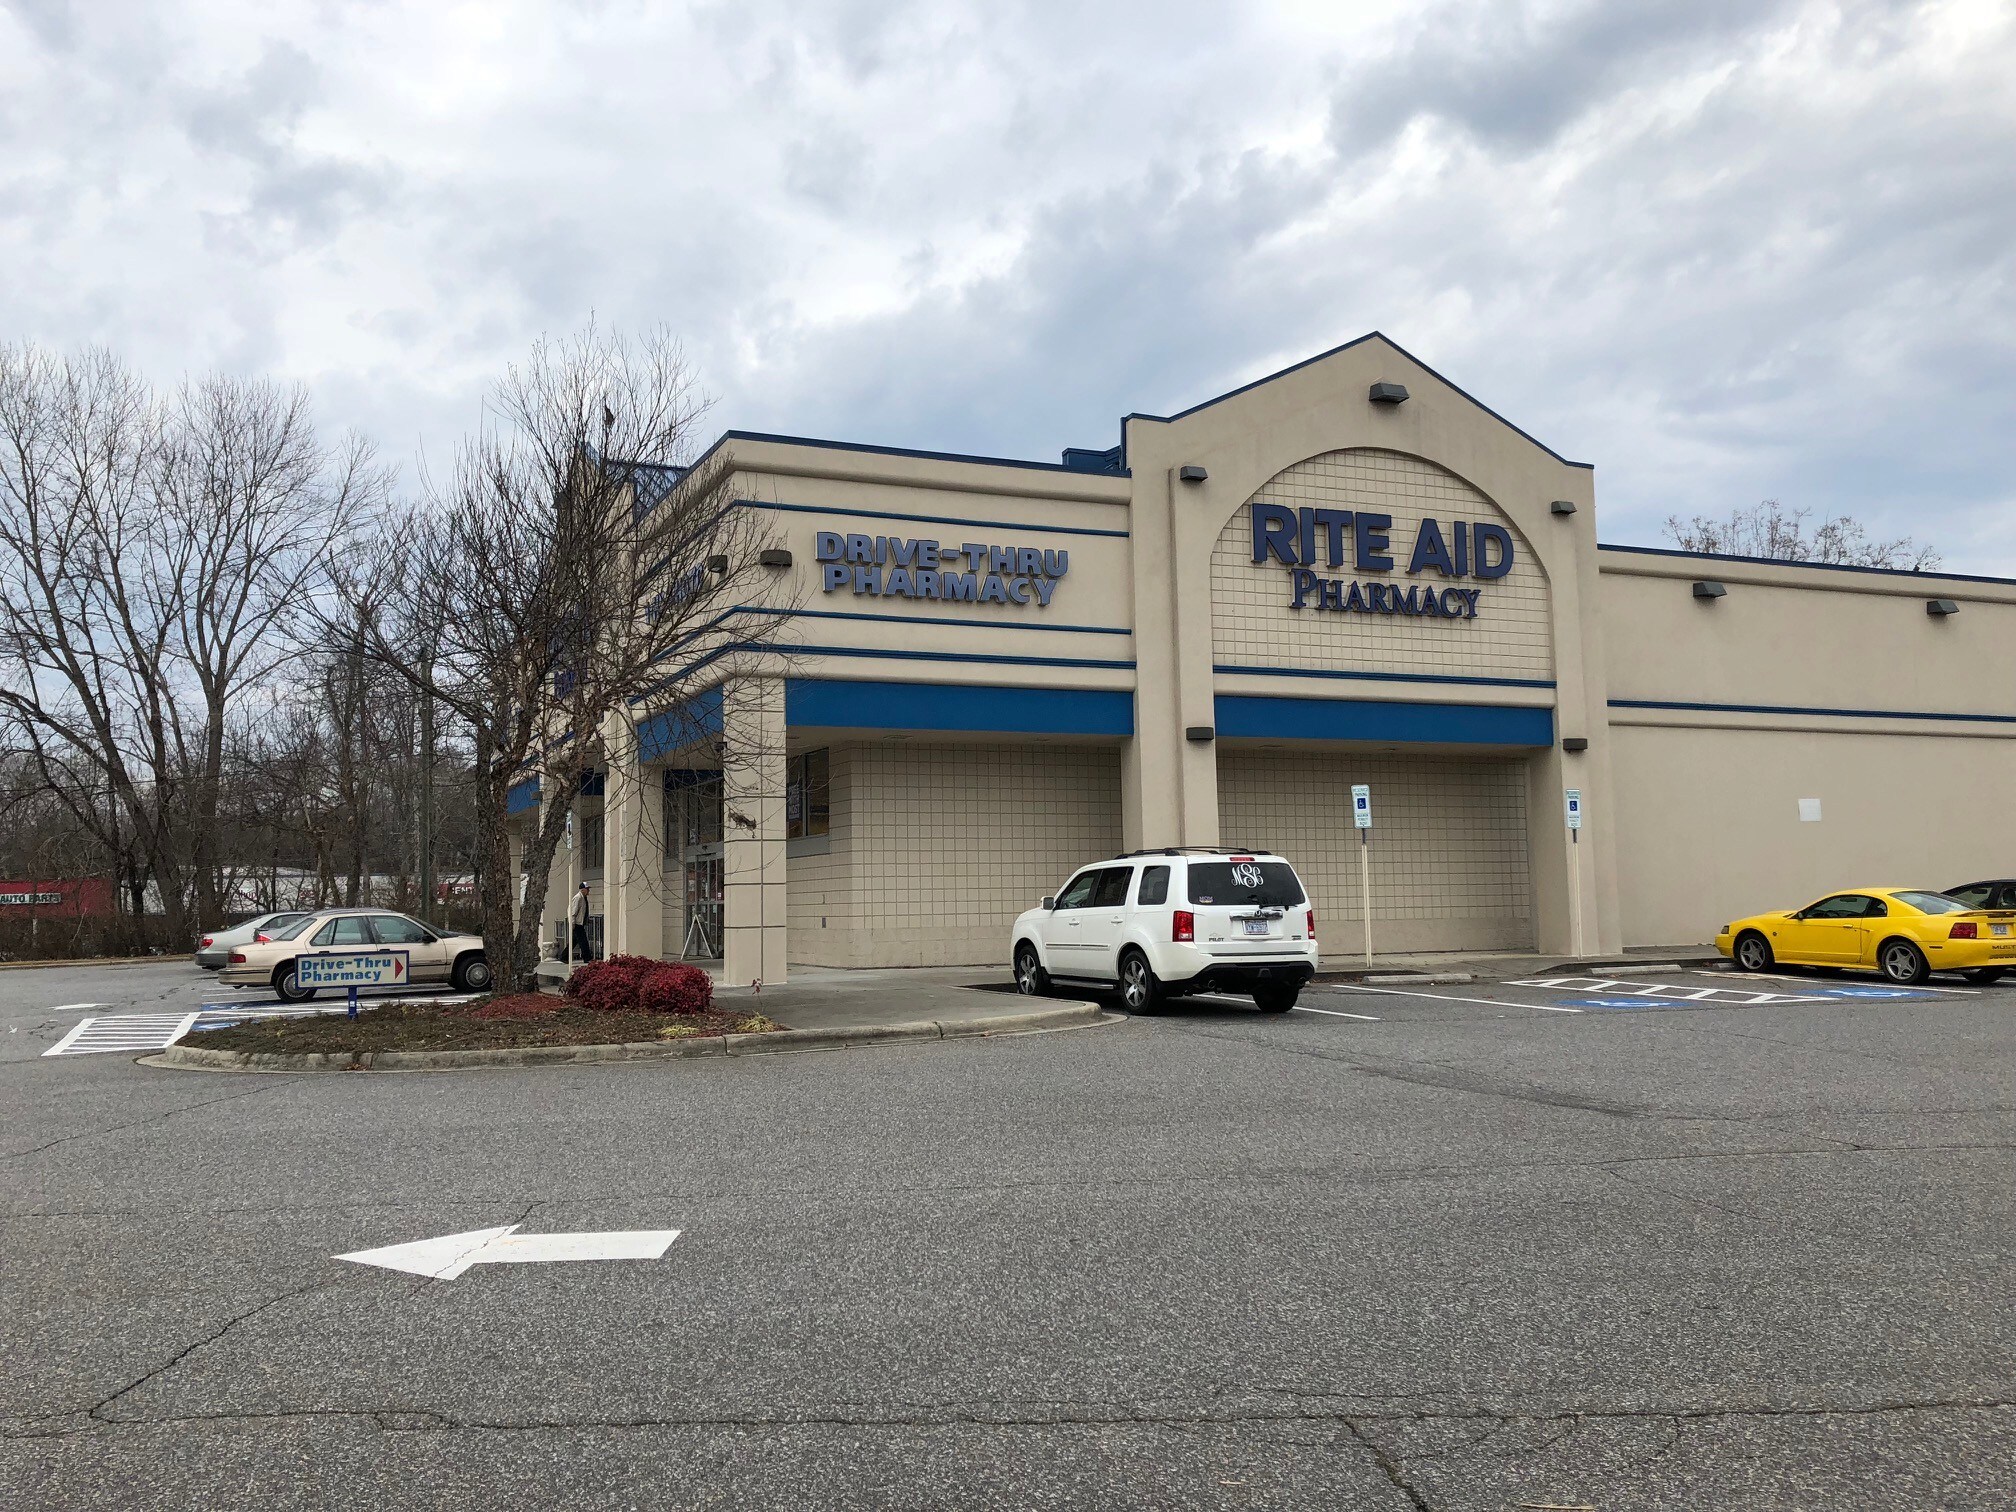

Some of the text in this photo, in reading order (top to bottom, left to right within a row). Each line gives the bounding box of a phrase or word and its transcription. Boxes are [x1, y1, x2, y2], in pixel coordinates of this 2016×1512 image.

[815, 531, 1069, 578] DRIVE-THRU
[1251, 502, 1515, 580] RITE AID
[822, 564, 1058, 607] PHARMACY
[1287, 567, 1482, 619] PHARMACY
[0, 894, 25, 903] AUTO
[301, 957, 391, 971] Drive-Thru
[301, 970, 382, 982] Pharmacy
